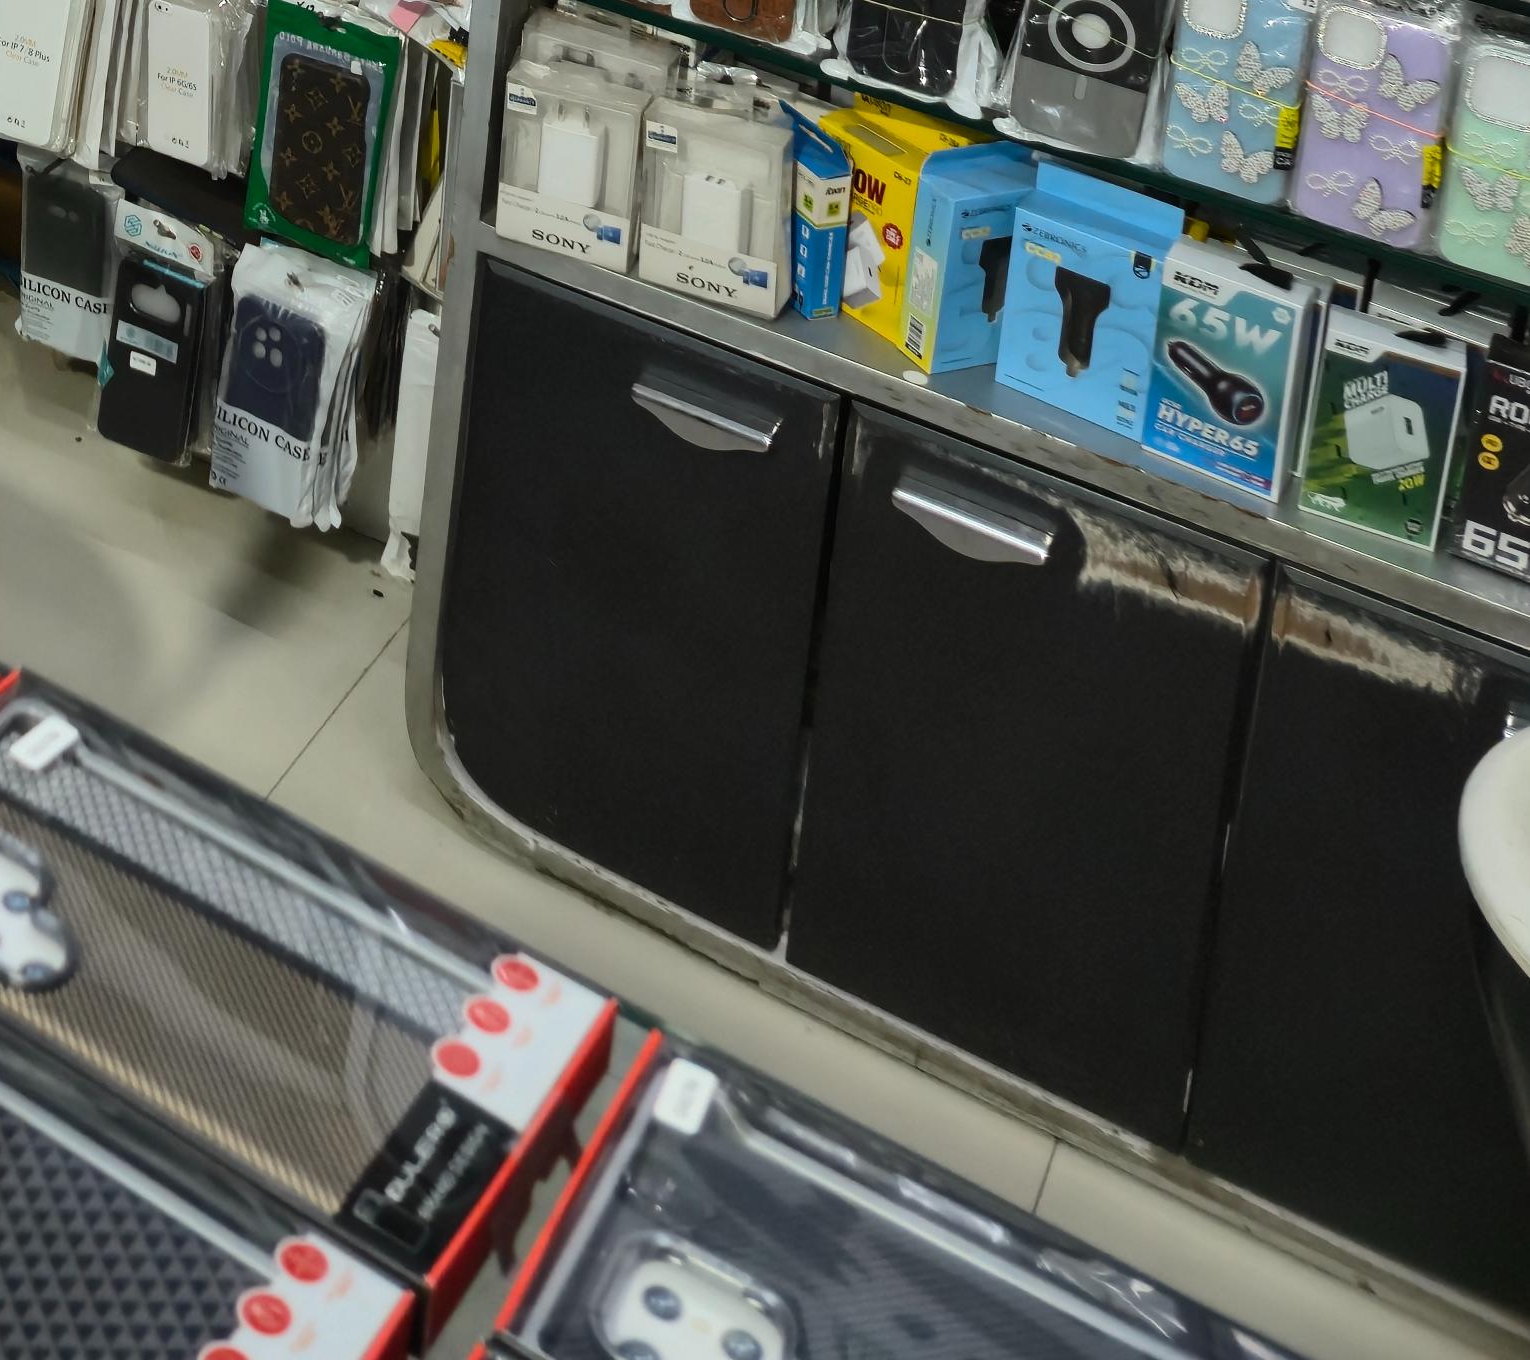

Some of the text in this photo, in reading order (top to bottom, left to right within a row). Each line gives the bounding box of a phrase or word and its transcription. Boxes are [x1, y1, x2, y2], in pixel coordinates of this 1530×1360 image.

[531, 228, 591, 255] SONY
[1032, 227, 1088, 257] ZEBRONICS
[23, 277, 71, 304] ILICON
[676, 271, 738, 299] SONY
[1174, 270, 1220, 297] KDM
[1169, 297, 1284, 350] 65W
[1335, 338, 1370, 355] KDM
[1343, 371, 1388, 399] MULTI
[1344, 388, 1388, 411] CHARGE
[216, 406, 311, 462] ILICON CASE
[1158, 406, 1260, 457] HYPER65
[1399, 473, 1426, 492] 20W
